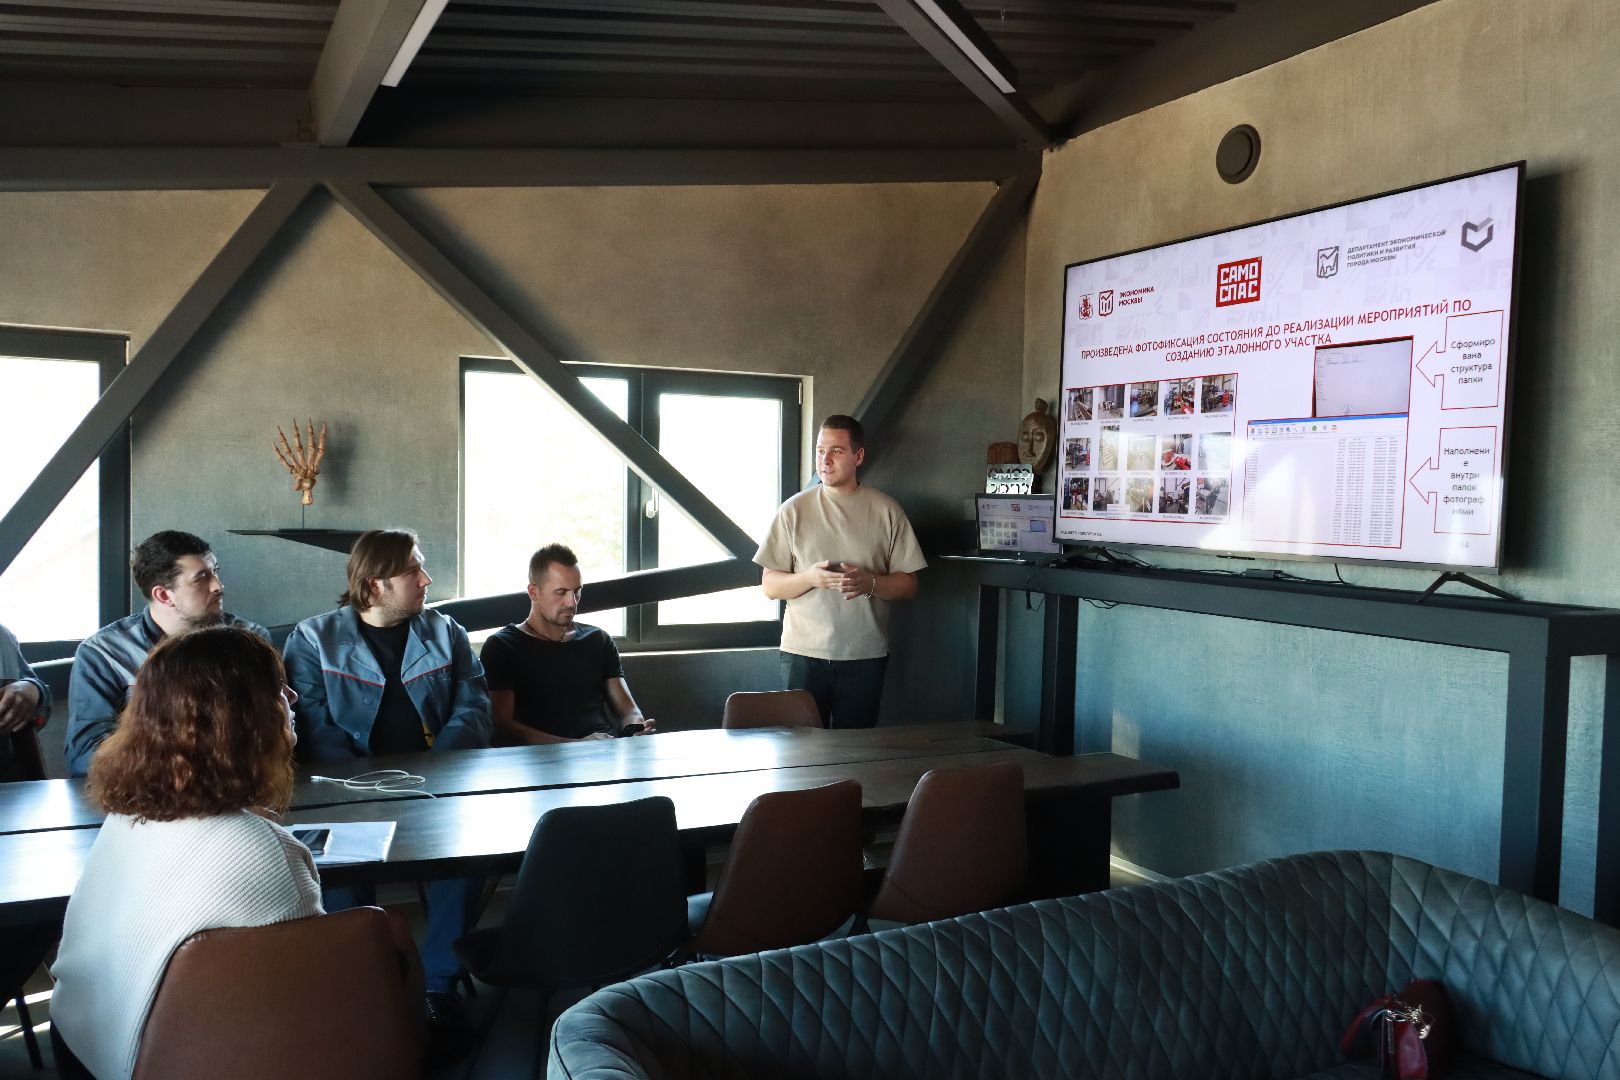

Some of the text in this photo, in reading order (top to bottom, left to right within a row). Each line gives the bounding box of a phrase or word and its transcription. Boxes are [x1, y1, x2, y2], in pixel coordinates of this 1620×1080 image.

[1347, 228, 1446, 254] ДЕПАРТАМЕНТ ЭКОНОМИЧЕСКОЙ
[1347, 250, 1378, 260] ПОЛИТИКИ
[1385, 243, 1416, 254] РАЗВИТИЯ
[1347, 255, 1397, 268] ГОРОДА МОСКВЫ
[1220, 261, 1259, 285] САМО
[1119, 286, 1155, 298] ЭКОНОМИКА
[1219, 280, 1258, 303] СПАС
[1119, 297, 1143, 307] МОСКВЫ
[1081, 299, 1472, 360] ПРОИЗВЕДЕНА ФОТОФИКСАЦИЯ СОСТОЯНИЯ ДО РЕАЛИЗАЦИИ МЕРОПРИЯТИЙ ПО
[1165, 333, 1332, 363] СОЗДАНИЮ ЭТАЛОННОГО УЧАСТКА
[1450, 338, 1496, 350] Сформиро
[1462, 352, 1482, 360] вана
[1450, 363, 1493, 374] структура
[1458, 376, 1484, 385] папки
[1443, 447, 1490, 456] Наполнени
[1450, 472, 1480, 481] внутри
[1452, 484, 1477, 492] папок
